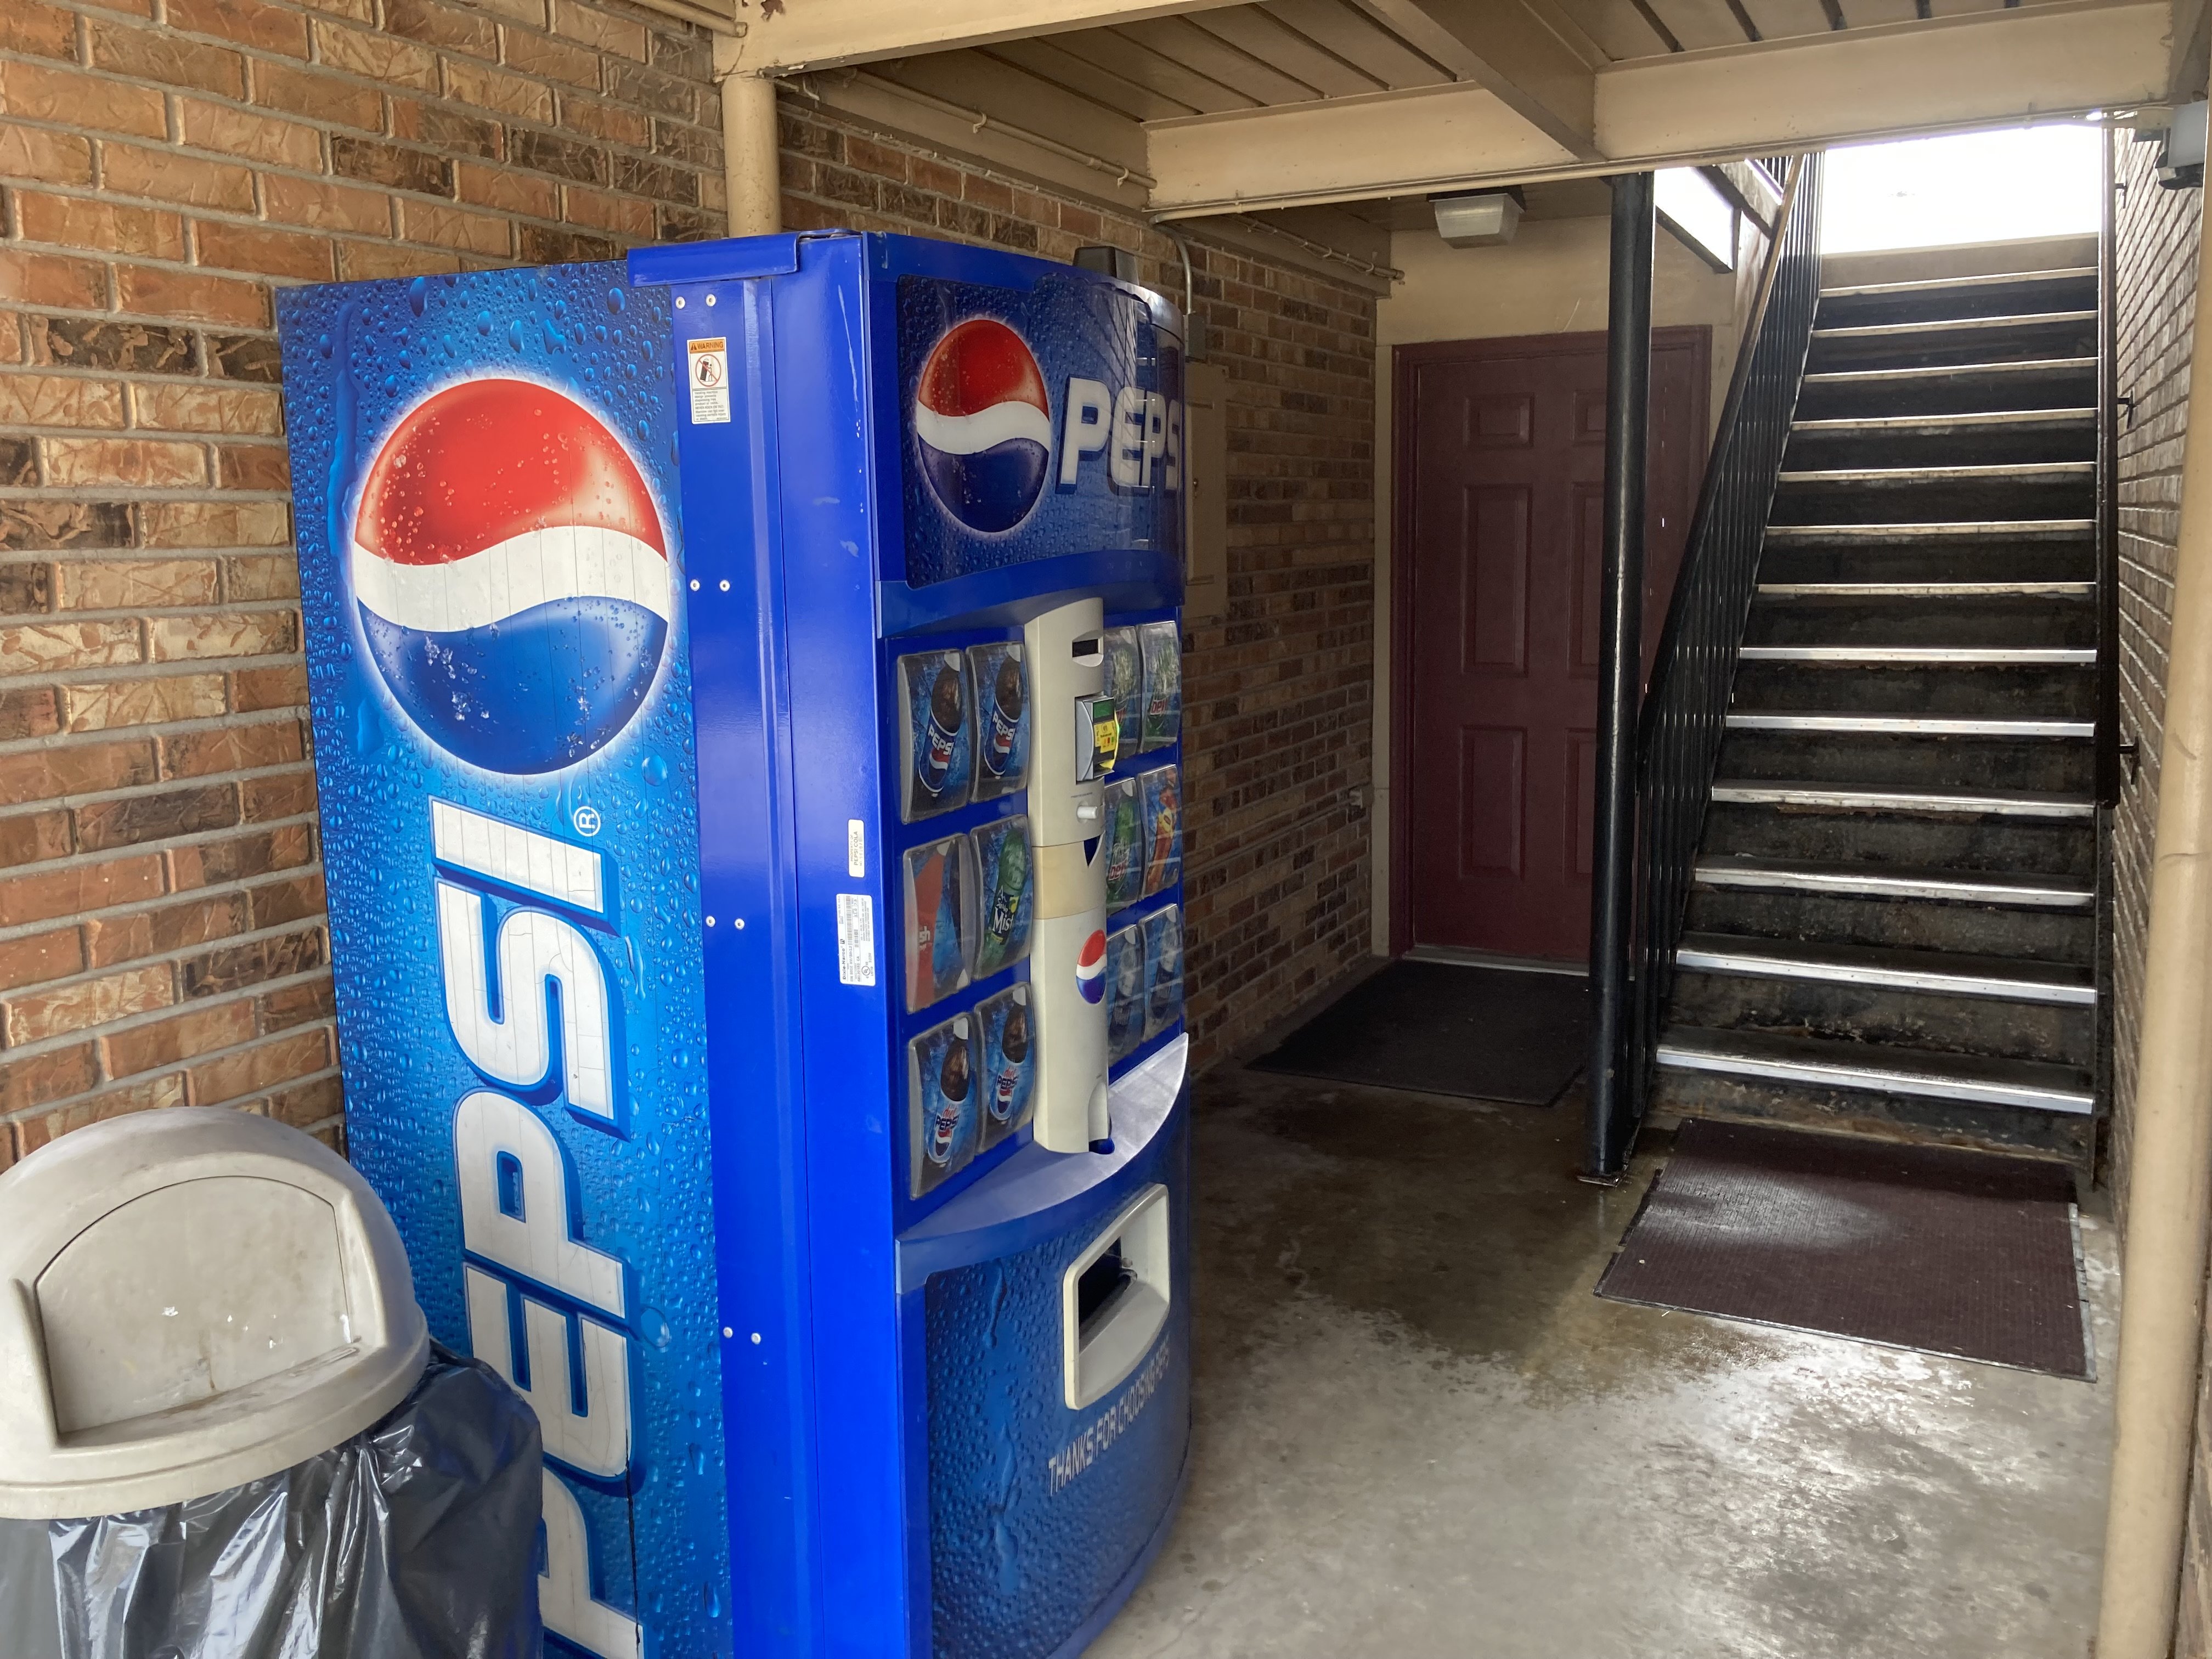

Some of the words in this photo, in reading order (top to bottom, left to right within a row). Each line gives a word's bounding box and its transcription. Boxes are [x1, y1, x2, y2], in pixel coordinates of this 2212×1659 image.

[1060, 377, 1180, 490] PEPS
[928, 724, 954, 755] PEPSI
[992, 711, 1015, 741] PEPSI
[992, 906, 1014, 934] Mist
[430, 798, 645, 1659] PEPSI
[1048, 1427, 1094, 1497] THANKS
[1096, 1404, 1116, 1458] FOR
